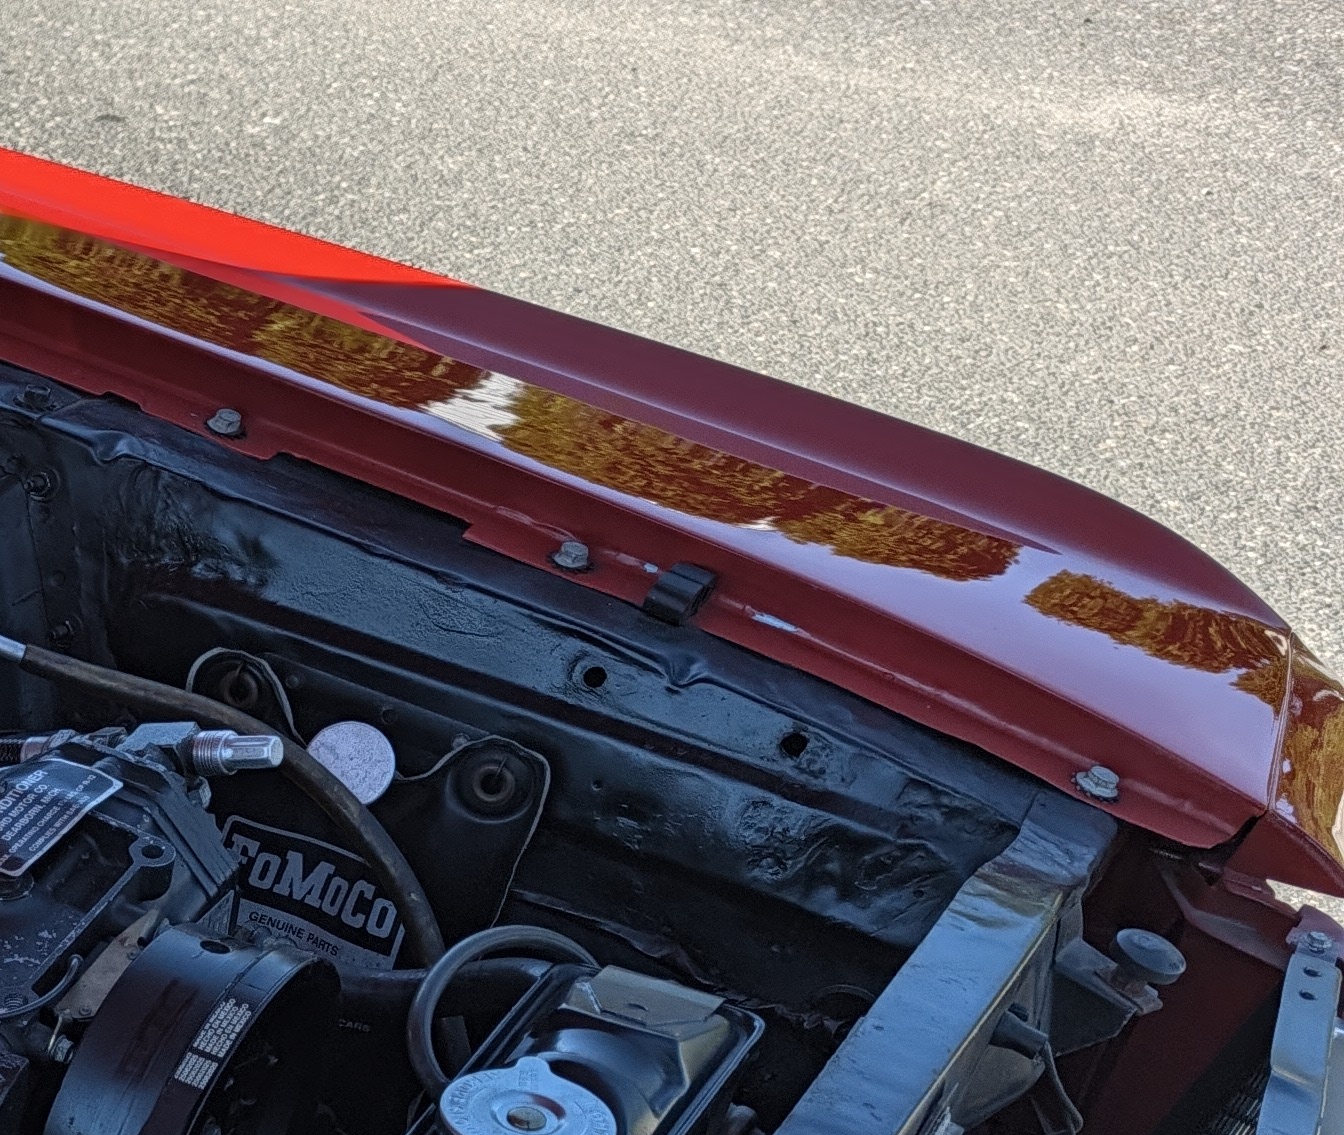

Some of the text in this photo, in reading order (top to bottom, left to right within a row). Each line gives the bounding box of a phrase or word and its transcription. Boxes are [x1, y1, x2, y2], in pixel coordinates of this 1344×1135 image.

[1, 803, 44, 841] DEARBORN,
[42, 786, 62, 803] MICH.
[8, 793, 36, 818] MOTOR
[34, 781, 49, 794] CO.
[9, 826, 40, 853] OPERATING
[37, 805, 60, 827] CHARGE
[29, 814, 69, 851] COMPLIES WITH
[248, 911, 341, 957] GENUINE PARTS
[205, 1035, 218, 1051] MADE
[221, 1006, 237, 1026] MEXICO
[218, 998, 234, 1018] MEXICO
[231, 1003, 247, 1023] MEXICO
[218, 1039, 231, 1056] MADE
[234, 1011, 250, 1031] MEXICO
